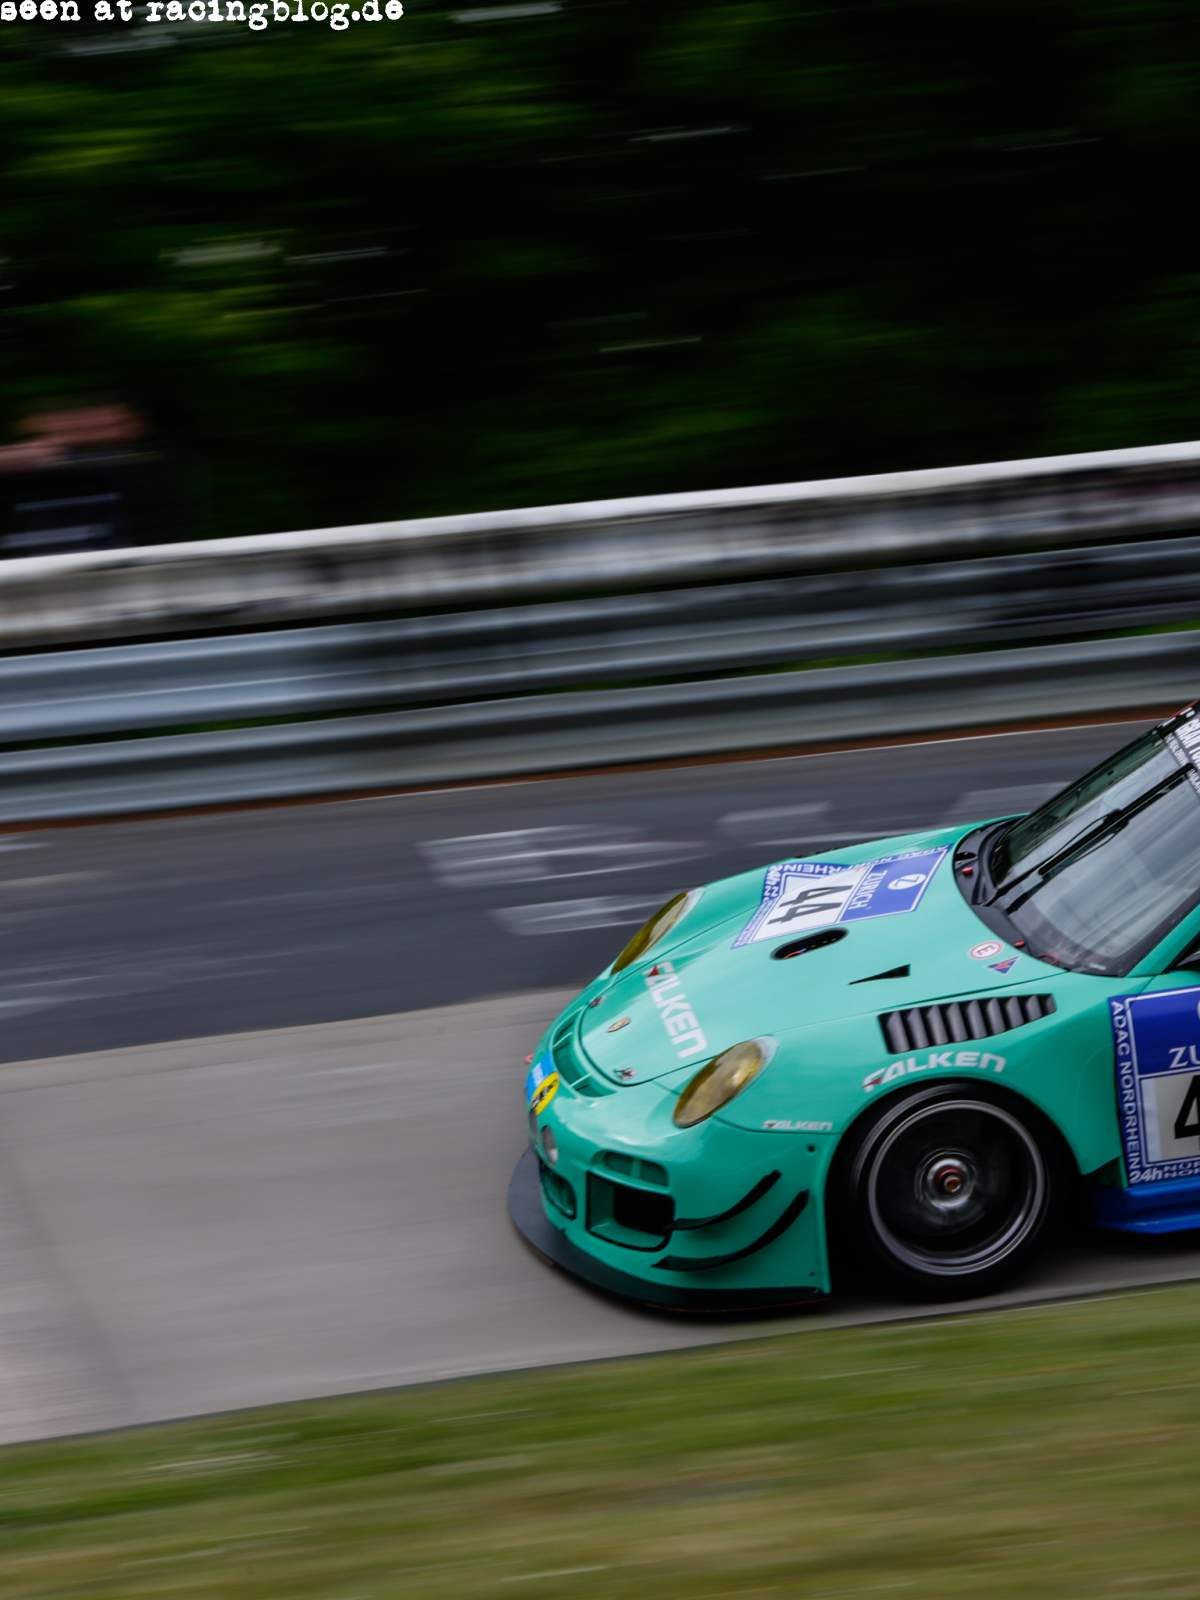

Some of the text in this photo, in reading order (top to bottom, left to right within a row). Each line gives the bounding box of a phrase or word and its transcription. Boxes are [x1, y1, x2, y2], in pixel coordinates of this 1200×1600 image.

[767, 884, 854, 925] 44
[848, 869, 888, 910] ZURICH
[1111, 1001, 1142, 1170] ADAC NORDRHEIN
